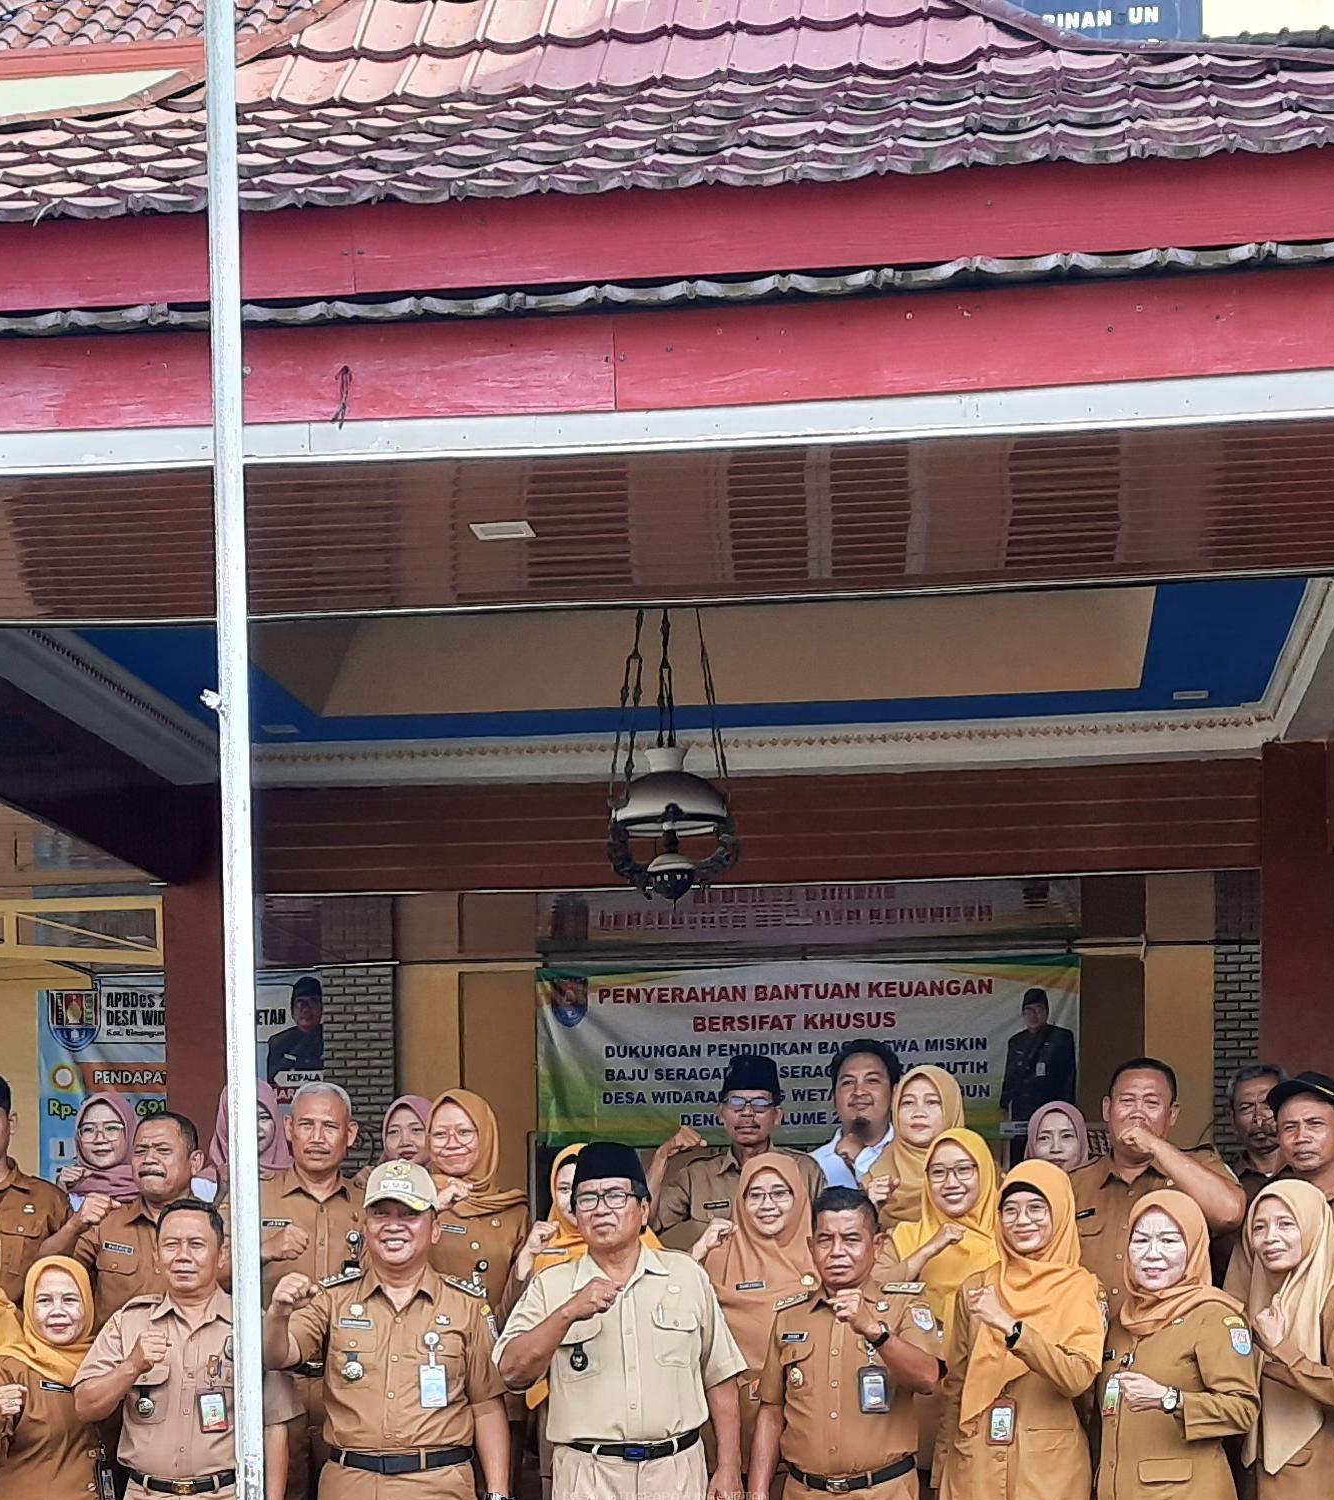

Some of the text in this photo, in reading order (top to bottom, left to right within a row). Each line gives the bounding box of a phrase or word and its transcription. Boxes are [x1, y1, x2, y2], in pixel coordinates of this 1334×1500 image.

[598, 979, 993, 1004] PENYERAHAN BANTUAN KEUANGAN
[106, 1009, 138, 1026] DESA
[693, 1011, 896, 1033] BERSIFAT KHUSUS
[605, 1044, 701, 1058] DUKUNGAN
[707, 1042, 812, 1057] PENDIDIKAN
[925, 1037, 987, 1052] MISKIN
[94, 1071, 166, 1084] PENDAPA
[287, 1073, 321, 1081] KEPALA
[605, 1068, 648, 1082] BAJU
[602, 1091, 647, 1104] DESA
[48, 1099, 77, 1119] Rp.
